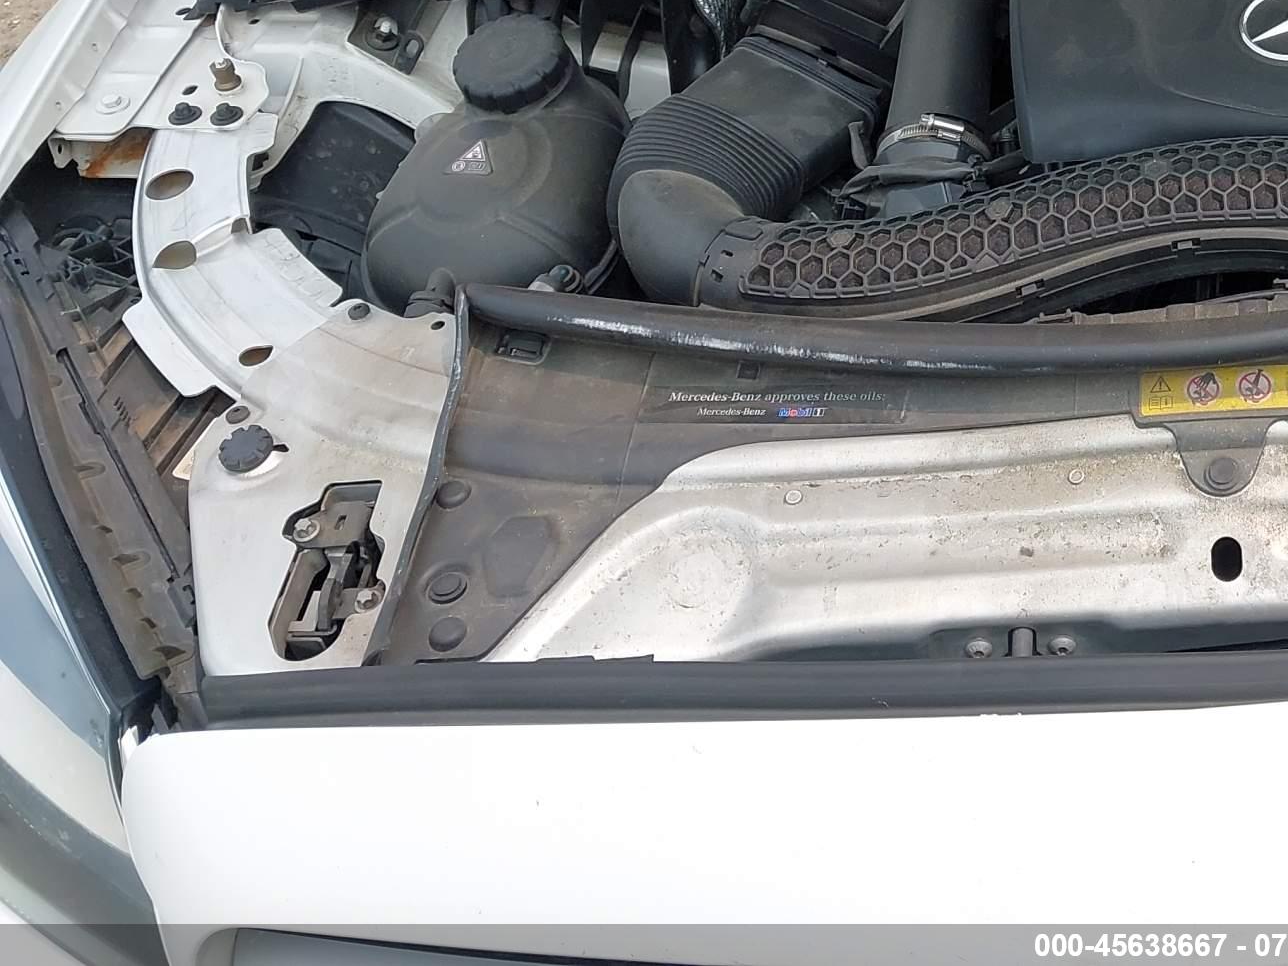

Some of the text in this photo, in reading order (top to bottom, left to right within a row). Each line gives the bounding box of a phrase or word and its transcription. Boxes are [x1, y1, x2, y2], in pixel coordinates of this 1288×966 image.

[668, 392, 762, 402] Mercedes-Benz
[764, 393, 820, 404] approves
[823, 391, 857, 401] these
[697, 407, 767, 416] Mercedes-Benz
[778, 407, 813, 418] Mobil
